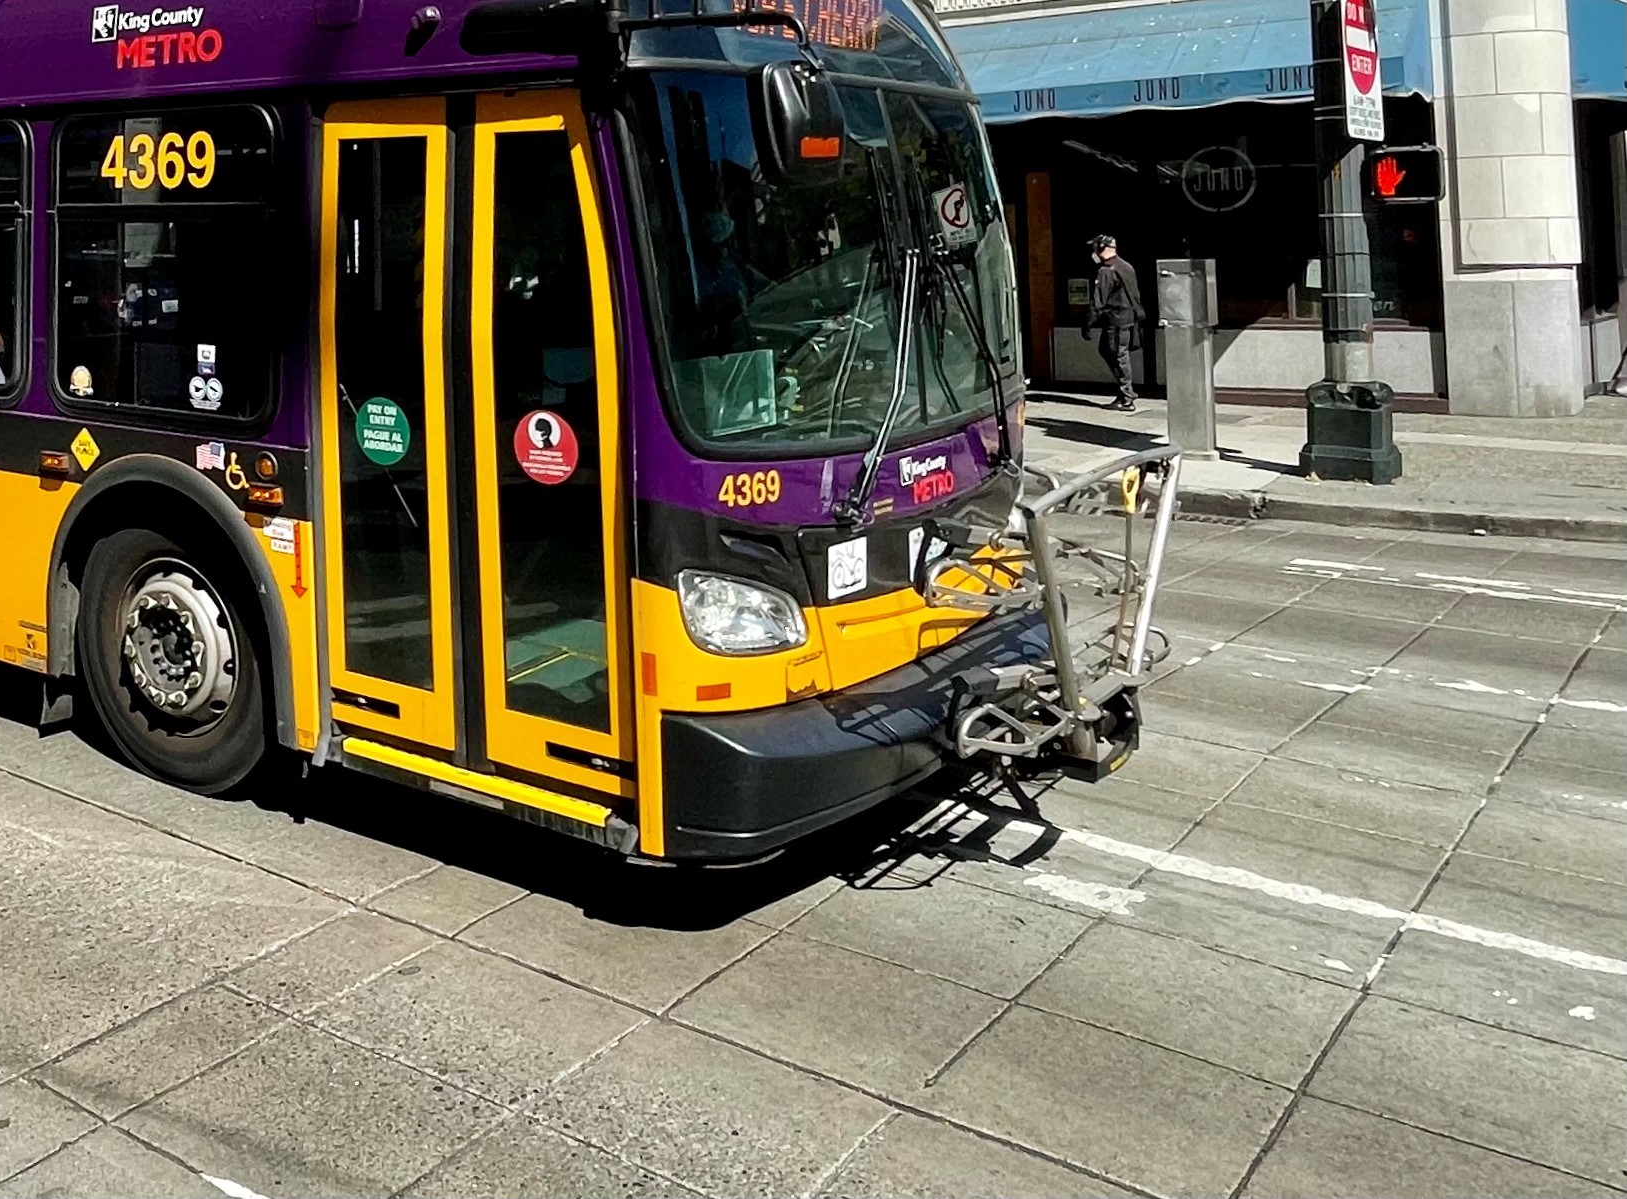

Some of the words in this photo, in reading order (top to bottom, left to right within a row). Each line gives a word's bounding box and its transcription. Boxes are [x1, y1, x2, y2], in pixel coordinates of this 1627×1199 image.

[118, 10, 151, 33] King
[151, 6, 204, 27] County
[1346, 1, 1357, 21] DO
[116, 28, 223, 70] METRO
[1350, 53, 1373, 75] ENTER
[1013, 87, 1056, 113] JUNO
[1133, 76, 1181, 103] JUNO
[100, 130, 216, 190] 4369
[1193, 166, 1244, 192] JUNO
[367, 404, 382, 414] PAY
[383, 406, 398, 416] ON
[369, 415, 396, 426] ENTRY
[363, 429, 390, 441] PAGUE
[391, 432, 403, 443] AL
[363, 440, 404, 453] ABORDAR
[718, 469, 781, 508] 4369
[914, 470, 954, 505] METRO
